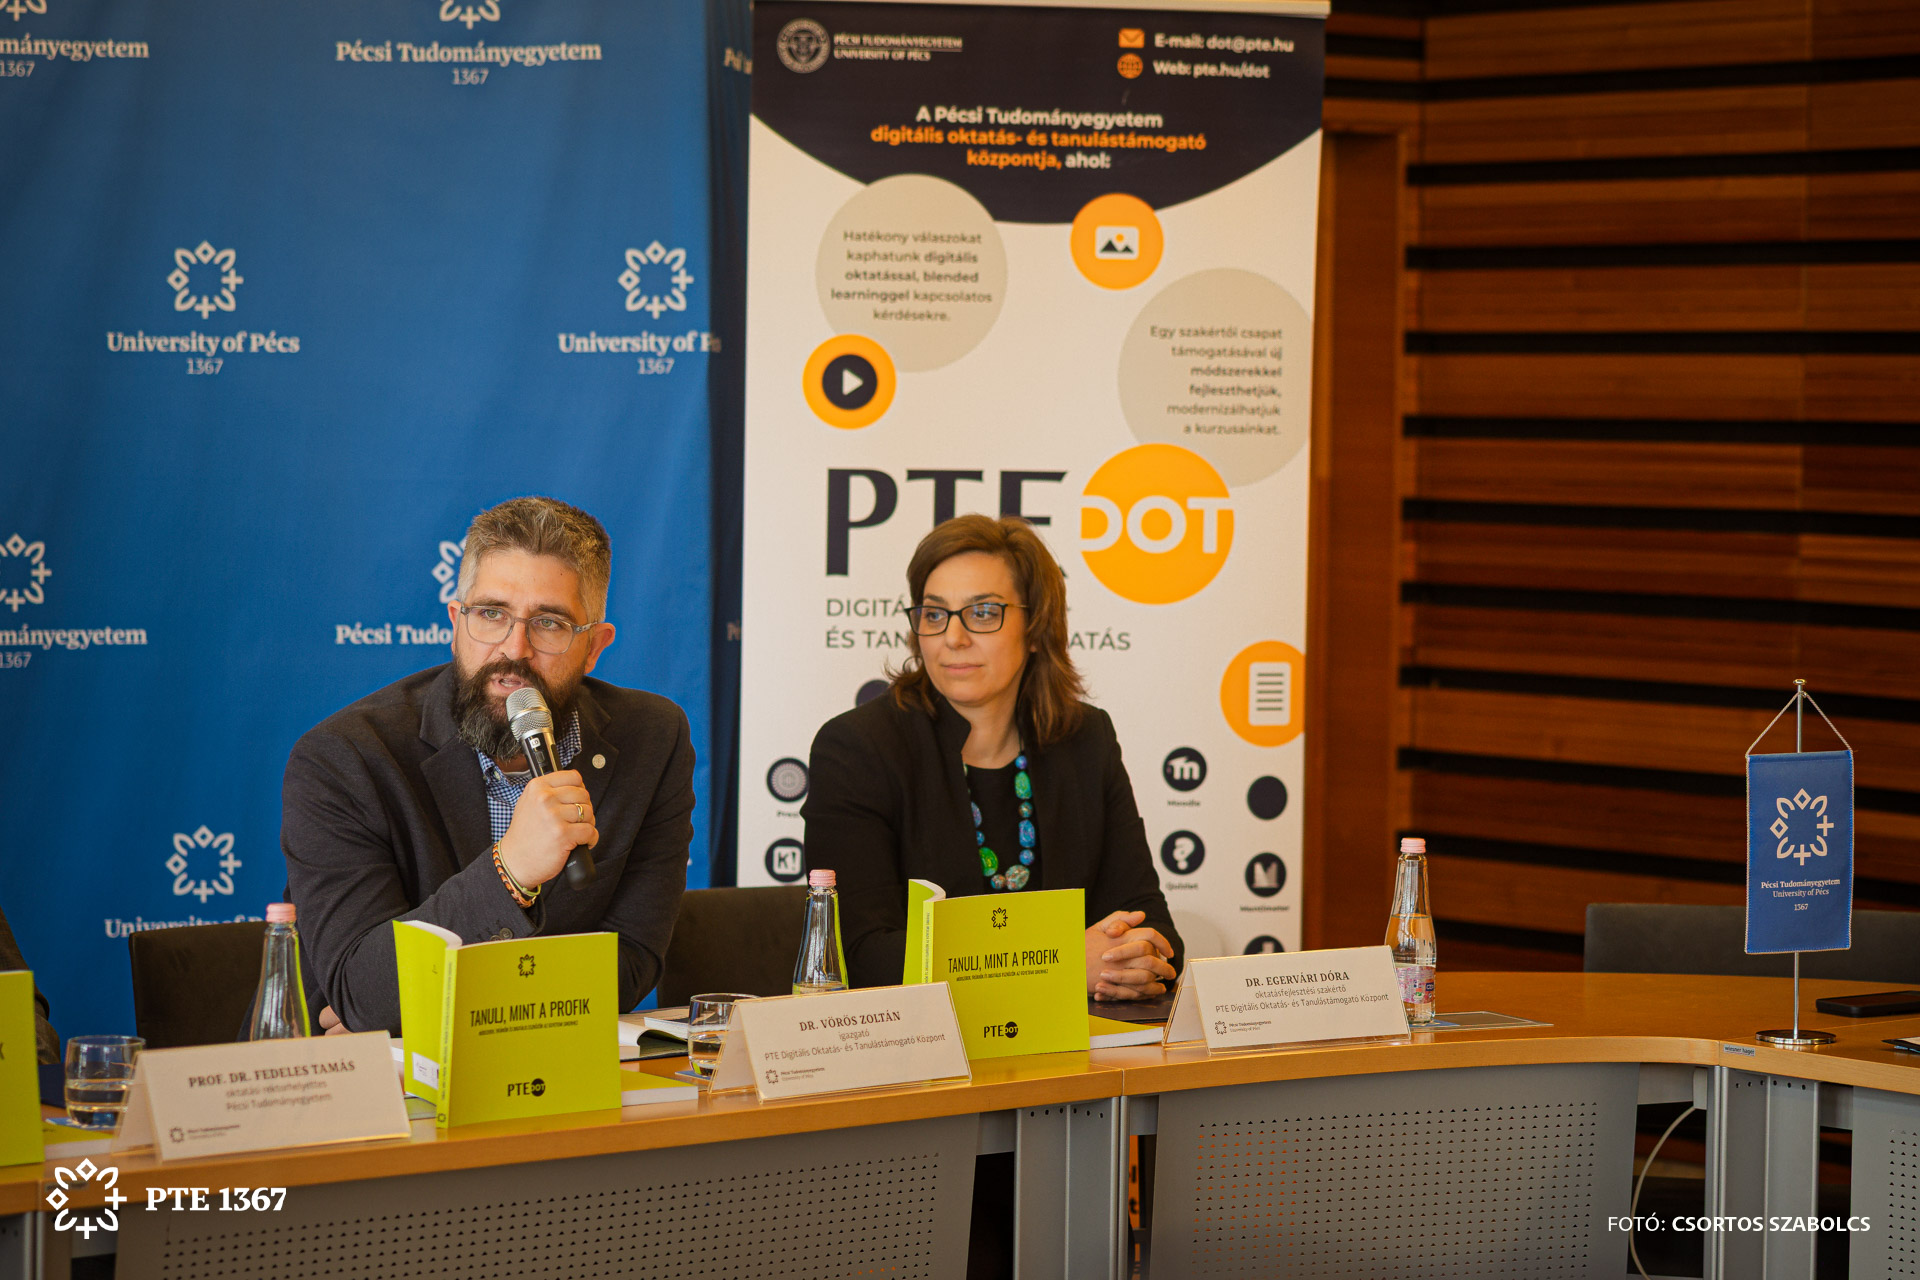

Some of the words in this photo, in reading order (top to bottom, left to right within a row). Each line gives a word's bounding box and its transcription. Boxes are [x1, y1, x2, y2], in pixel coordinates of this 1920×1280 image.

[1154, 33, 1204, 48] E-mail:
[1206, 34, 1294, 53] dot@pte.hu
[336, 40, 392, 62] Pécsi
[397, 41, 602, 67] Tudományegyetem
[452, 68, 489, 85] 1367
[1153, 60, 1191, 75] Web:
[1193, 62, 1270, 79] pte.hu/dot
[916, 106, 930, 122] A
[935, 105, 983, 124] Pécsi
[985, 107, 1163, 130] Tudományegyetem
[870, 124, 944, 146] digitális
[947, 127, 1023, 146] oktatás-
[1026, 129, 1048, 147] és
[1051, 131, 1206, 152] tanulástámogató
[967, 149, 1062, 169] központja,
[1064, 152, 1111, 169] ahol:
[843, 231, 909, 245] Hatékony
[912, 231, 982, 244] válaszokat
[846, 250, 921, 263] kaphatunk
[924, 251, 978, 265] digitális
[845, 270, 919, 283] oktatással,
[923, 272, 979, 283] blended
[831, 288, 910, 303] learninggel
[913, 290, 993, 303] kapcsolatos
[873, 309, 950, 321] kérdésekre.
[1150, 326, 1176, 339] Egy
[1240, 328, 1283, 339] csapat
[107, 330, 220, 357] University
[222, 331, 247, 353] of
[250, 330, 300, 353] Pécs
[558, 331, 671, 357] University
[673, 330, 698, 352] of
[1171, 346, 1267, 359] támogatásával
[1270, 347, 1283, 361] új
[186, 358, 224, 375] 1367
[638, 358, 675, 375] 1367
[1190, 366, 1282, 377] módszerekkel
[1166, 404, 1280, 418] modernizálhatjuk
[1184, 424, 1191, 434] a
[1194, 423, 1281, 435] kurzusainkat.
[1081, 494, 1234, 554] DOT
[335, 622, 392, 645] Pécsi
[826, 628, 855, 649] ÉS
[1761, 880, 1779, 889] Pécsi
[1780, 879, 1840, 890] Tudományegyetem
[1773, 888, 1806, 898] University
[1807, 888, 1815, 896] of
[1815, 887, 1829, 895] Pécs
[1794, 903, 1808, 911] 1367
[948, 956, 982, 973] TANULJ,
[984, 952, 1009, 970] MINT
[1011, 951, 1019, 967] A
[1022, 948, 1060, 966] PROFIK
[1245, 977, 1264, 988] DR.
[1266, 972, 1318, 986] EGERVÁRI
[1320, 970, 1350, 983] DÓRA
[1255, 986, 1316, 999] oktatásfejlesztési
[1317, 984, 1347, 995] szakértő
[1215, 1004, 1230, 1014] PTE
[1231, 1001, 1259, 1013] Digitális
[1259, 999, 1290, 1010] Oktatás-
[1291, 999, 1300, 1008] és
[1300, 994, 1360, 1008] Tanulástámogató
[1360, 992, 1389, 1004] Központ
[470, 1005, 507, 1028] TANULJ,
[509, 1003, 536, 1021] MINT
[539, 1001, 547, 1018] A
[550, 998, 590, 1018] PROFIK
[799, 1020, 819, 1032] DR.
[820, 1015, 858, 1029] VÖRÖS
[859, 1009, 901, 1025] ZOLTÁN
[839, 1028, 870, 1042] igazgató
[983, 1025, 1004, 1038] PTE
[764, 1052, 780, 1061] PTE
[781, 1046, 811, 1060] Digitális
[811, 1044, 843, 1056] Oktatás-
[844, 1042, 853, 1052] és
[854, 1036, 916, 1051] Tanulástámogató
[916, 1032, 946, 1045] Központ
[188, 1072, 227, 1088] PROF.
[229, 1070, 252, 1084] DR.
[254, 1065, 309, 1081] FEDELES
[310, 1058, 355, 1075] TAMÁS
[507, 1082, 530, 1097] PTE
